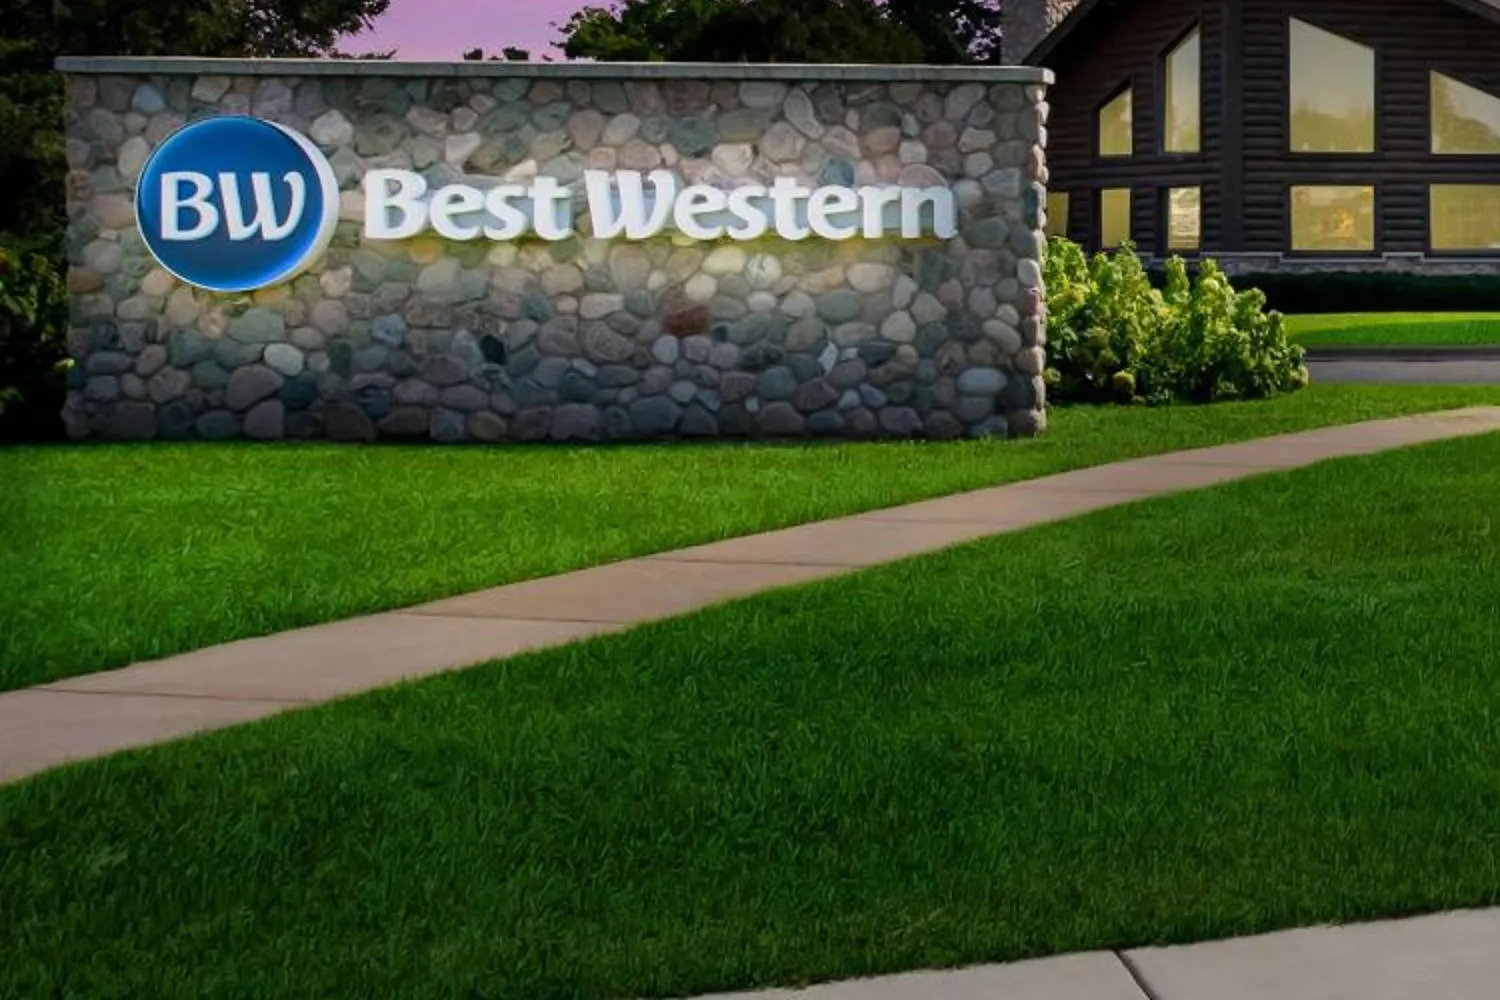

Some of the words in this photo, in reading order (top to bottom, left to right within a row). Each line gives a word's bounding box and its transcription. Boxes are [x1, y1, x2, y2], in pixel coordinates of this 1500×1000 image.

[160, 171, 306, 241] BW
[364, 168, 574, 241] Best
[584, 168, 957, 241] Western
